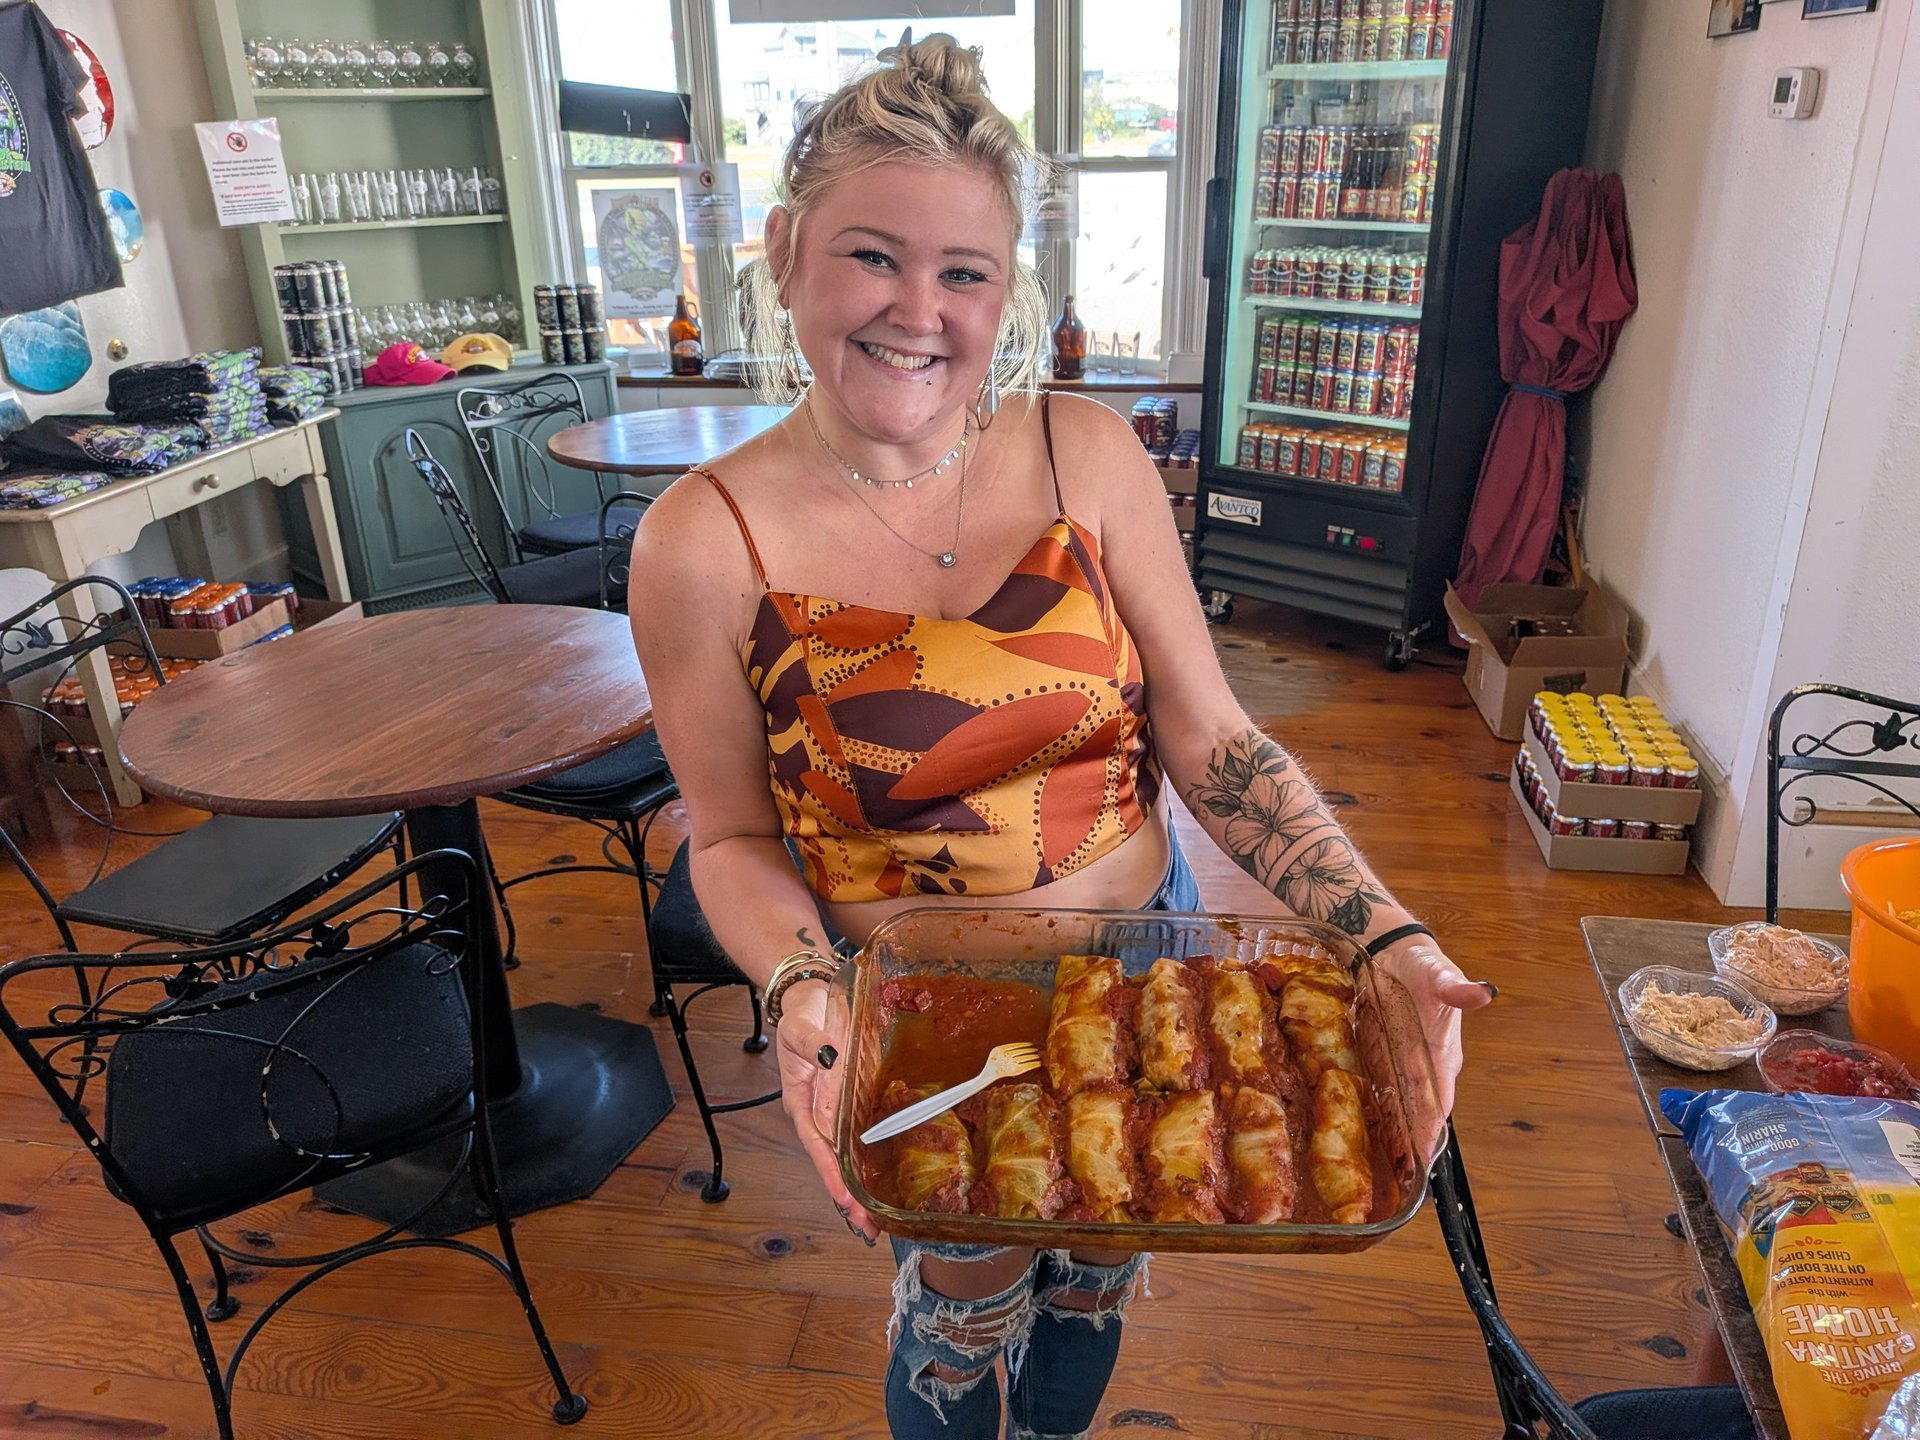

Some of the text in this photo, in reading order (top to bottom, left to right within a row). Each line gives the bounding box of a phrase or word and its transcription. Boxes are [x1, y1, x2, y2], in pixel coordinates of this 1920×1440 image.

[1744, 1134, 1783, 1152] IS WORTH
[1770, 1137, 1800, 1152] GOOD
[1778, 1250, 1851, 1266] CHIPS & DIPS
[1823, 1264, 1846, 1274] THE
[1847, 1264, 1866, 1274] ON
[1787, 1276, 1816, 1286] TASTE
[1816, 1276, 1874, 1286] AUTHENTIC
[1807, 1288, 1848, 1299] with the
[1780, 1303, 1900, 1338] HOME
[1784, 1333, 1916, 1369] CANTINA
[1820, 1360, 1902, 1386] BRING THE
